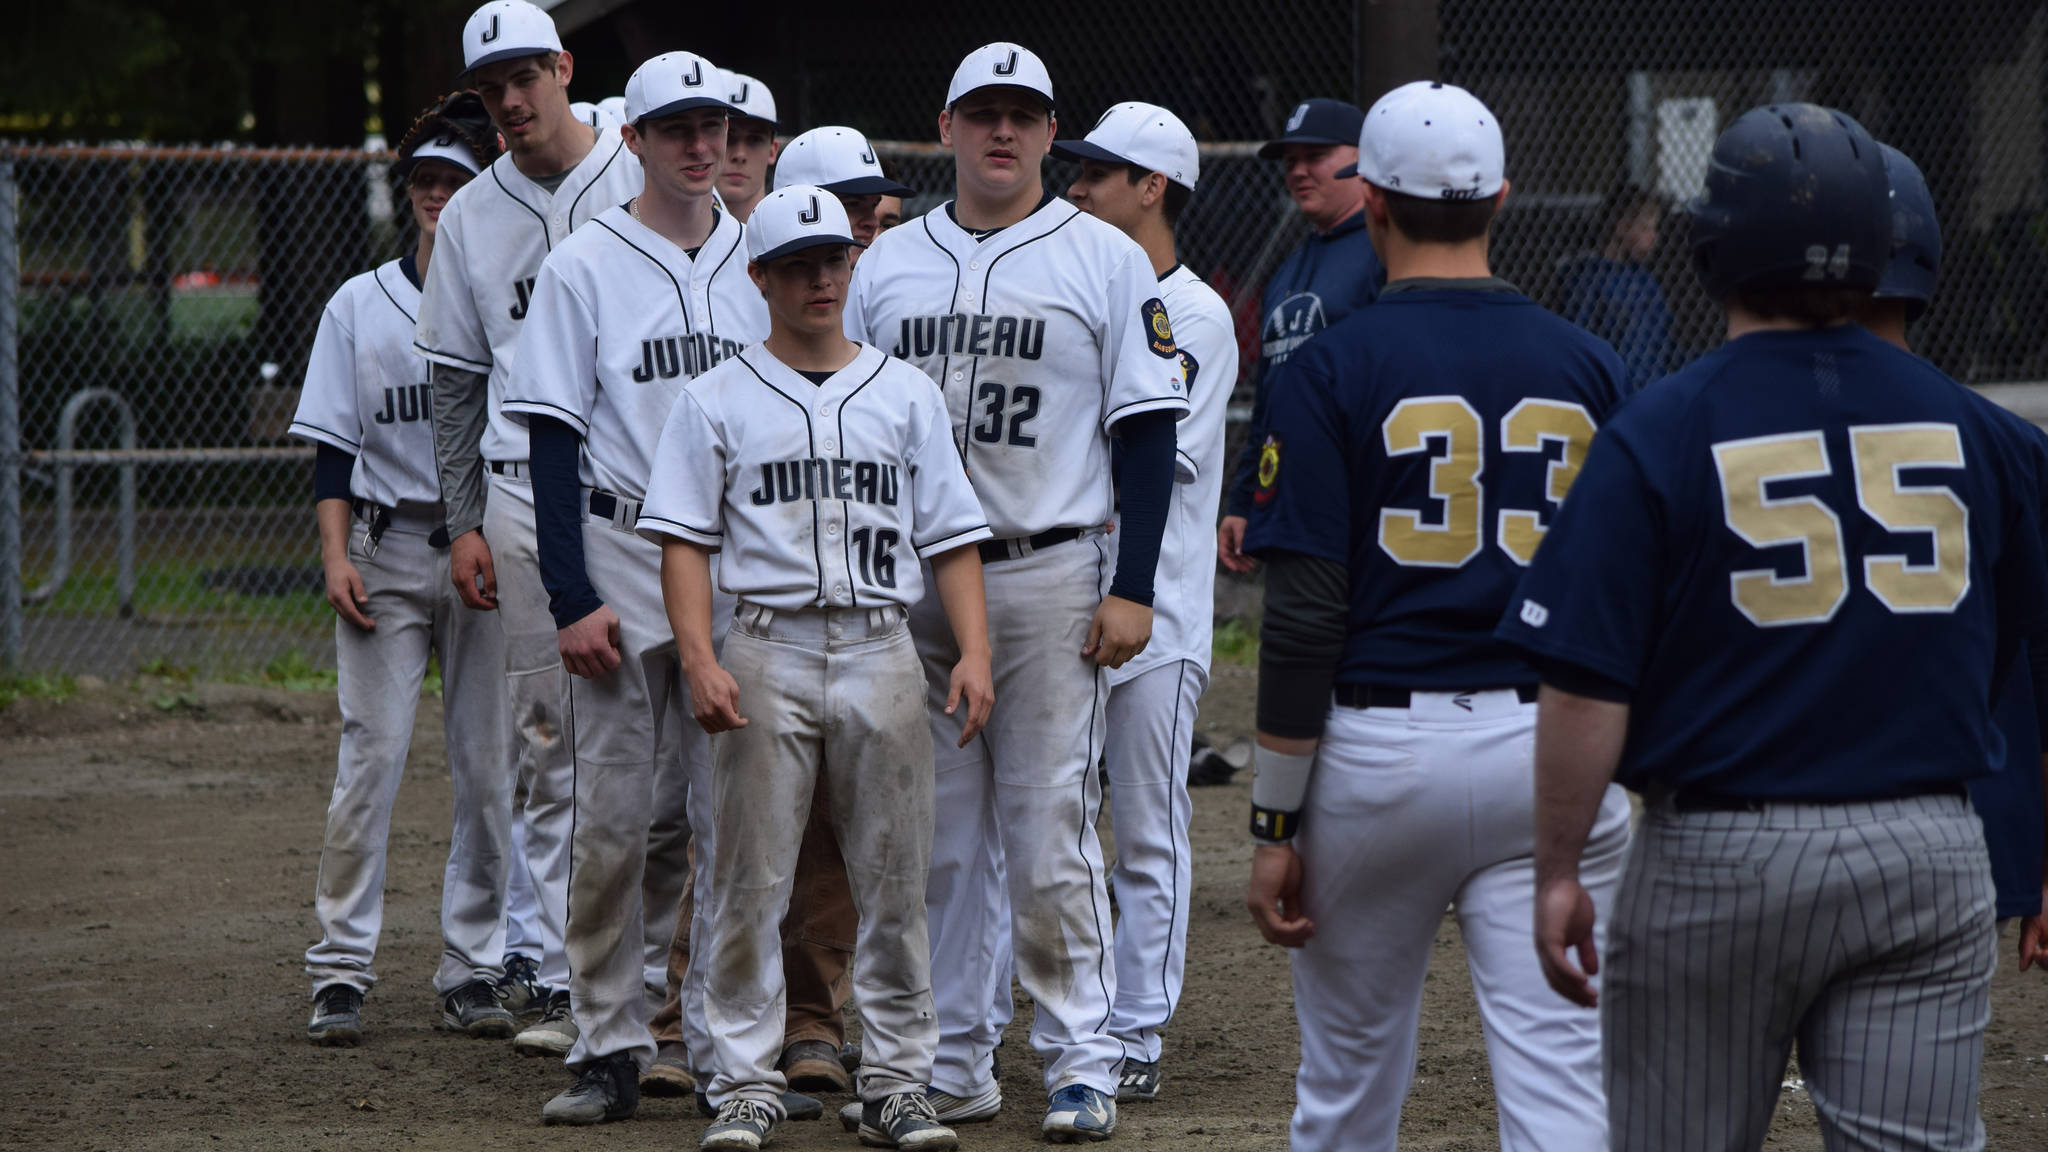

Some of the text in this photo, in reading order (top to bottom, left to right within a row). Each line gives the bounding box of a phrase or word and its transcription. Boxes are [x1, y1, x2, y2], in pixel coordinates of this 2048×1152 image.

[480, 13, 501, 44] J
[681, 59, 704, 88] J
[992, 50, 1019, 78] J
[729, 82, 749, 104] J
[1286, 103, 1311, 132] J
[861, 138, 877, 166] J
[797, 194, 822, 225] J
[893, 312, 1047, 361] JUNEAU
[632, 332, 748, 383] JUNE
[974, 380, 1041, 448] 32
[750, 457, 899, 506] JUNEAU
[1378, 395, 1598, 569] 33
[1710, 421, 1971, 628] 55
[852, 525, 900, 589] 16
